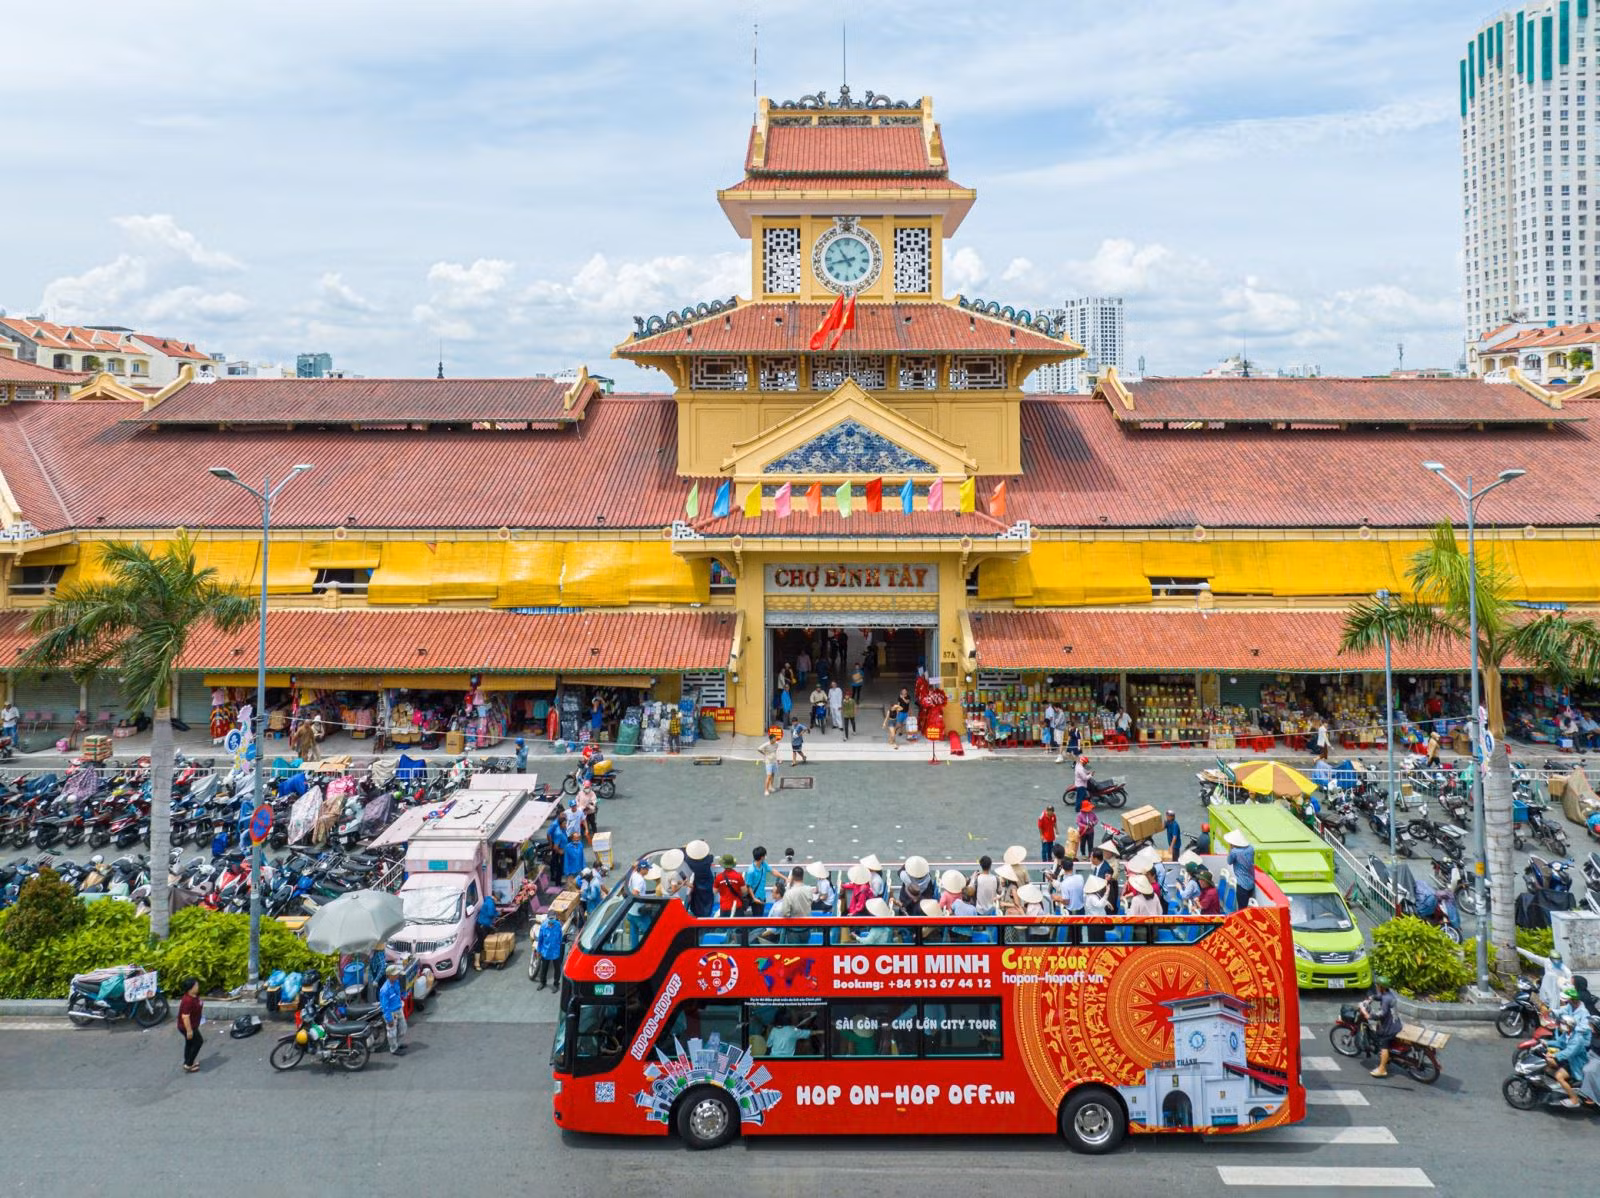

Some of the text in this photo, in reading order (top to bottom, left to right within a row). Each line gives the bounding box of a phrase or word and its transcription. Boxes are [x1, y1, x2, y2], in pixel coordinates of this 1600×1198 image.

[774, 563, 928, 592] CHỢ BÌNH TÂY
[833, 954, 990, 974] HO CHI MINH
[833, 979, 992, 991] Booking: +84 913 67 44 12
[1002, 970, 1104, 986] hopon-hopoff.vn
[630, 1032, 649, 1060] HOP
[666, 972, 682, 997] OFF
[835, 1016, 853, 1030] SÀI
[857, 1016, 878, 1030] GÒN
[891, 1018, 913, 1032] CHỢ
[940, 1018, 965, 1030] CITY
[969, 1018, 997, 1030] TOUR
[796, 1085, 842, 1105] HOP
[849, 1084, 940, 1105] ON-HOP
